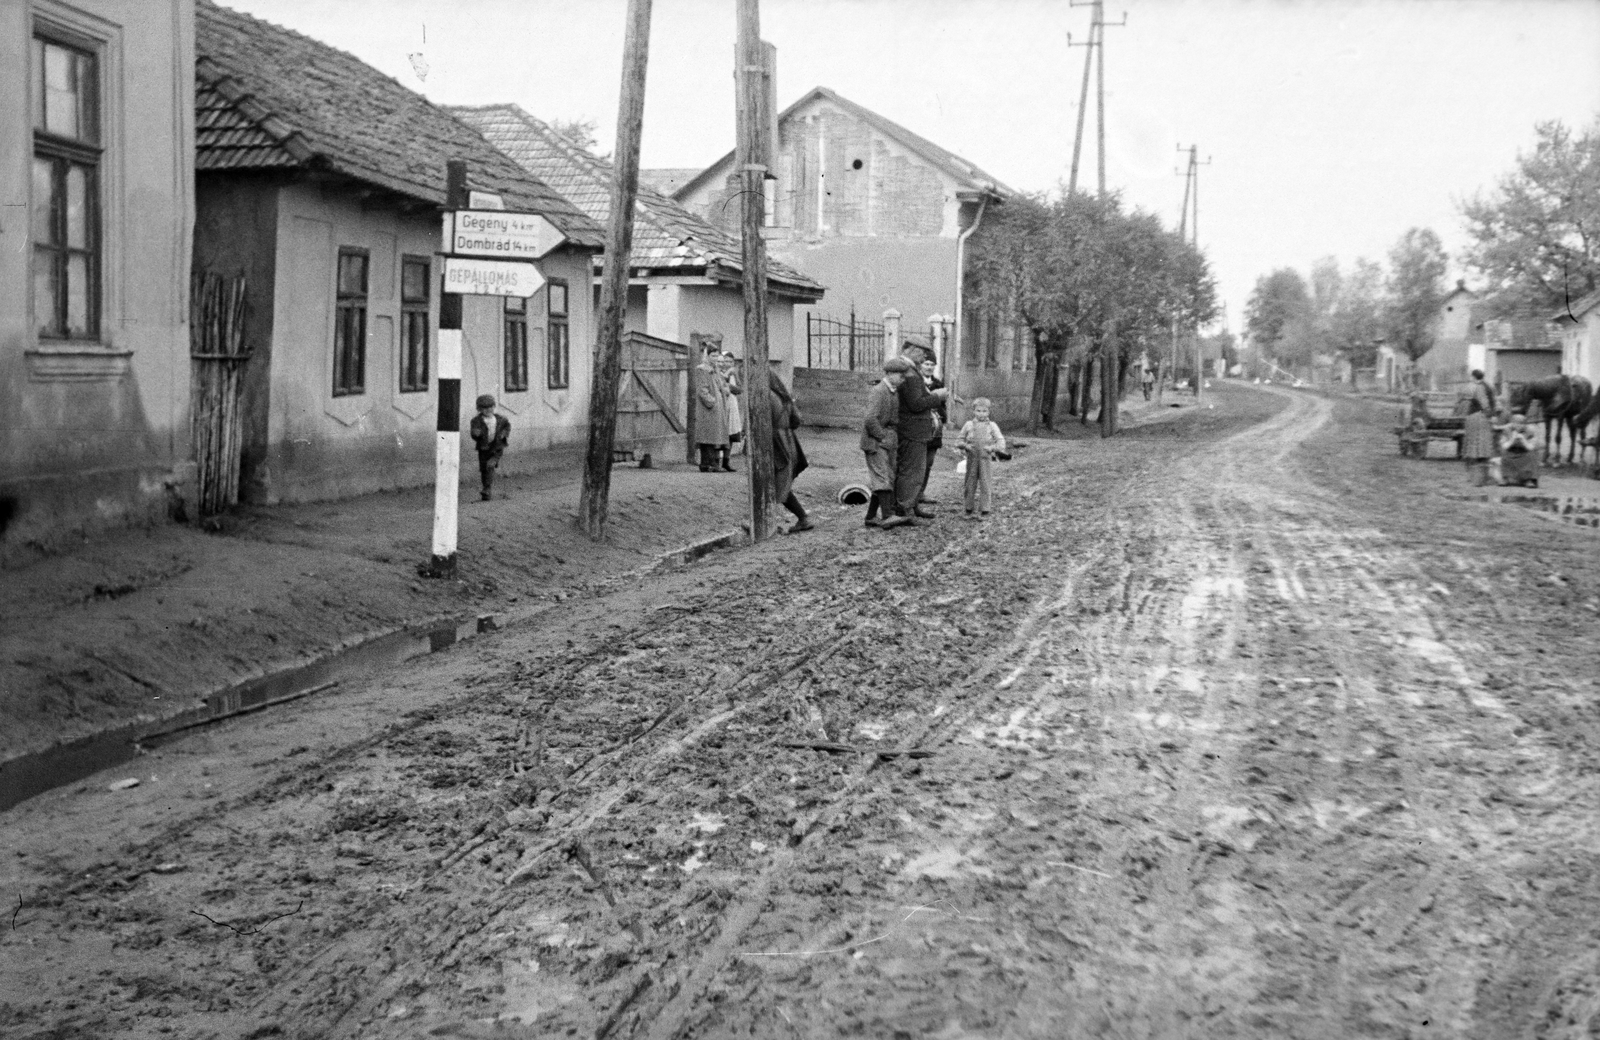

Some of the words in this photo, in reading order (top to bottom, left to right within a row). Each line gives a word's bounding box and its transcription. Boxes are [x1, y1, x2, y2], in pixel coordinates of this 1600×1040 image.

[512, 220, 518, 230] 4
[520, 221, 534, 230] km
[457, 236, 510, 251] Dombrád
[512, 240, 522, 251] 14
[524, 243, 536, 252] km
